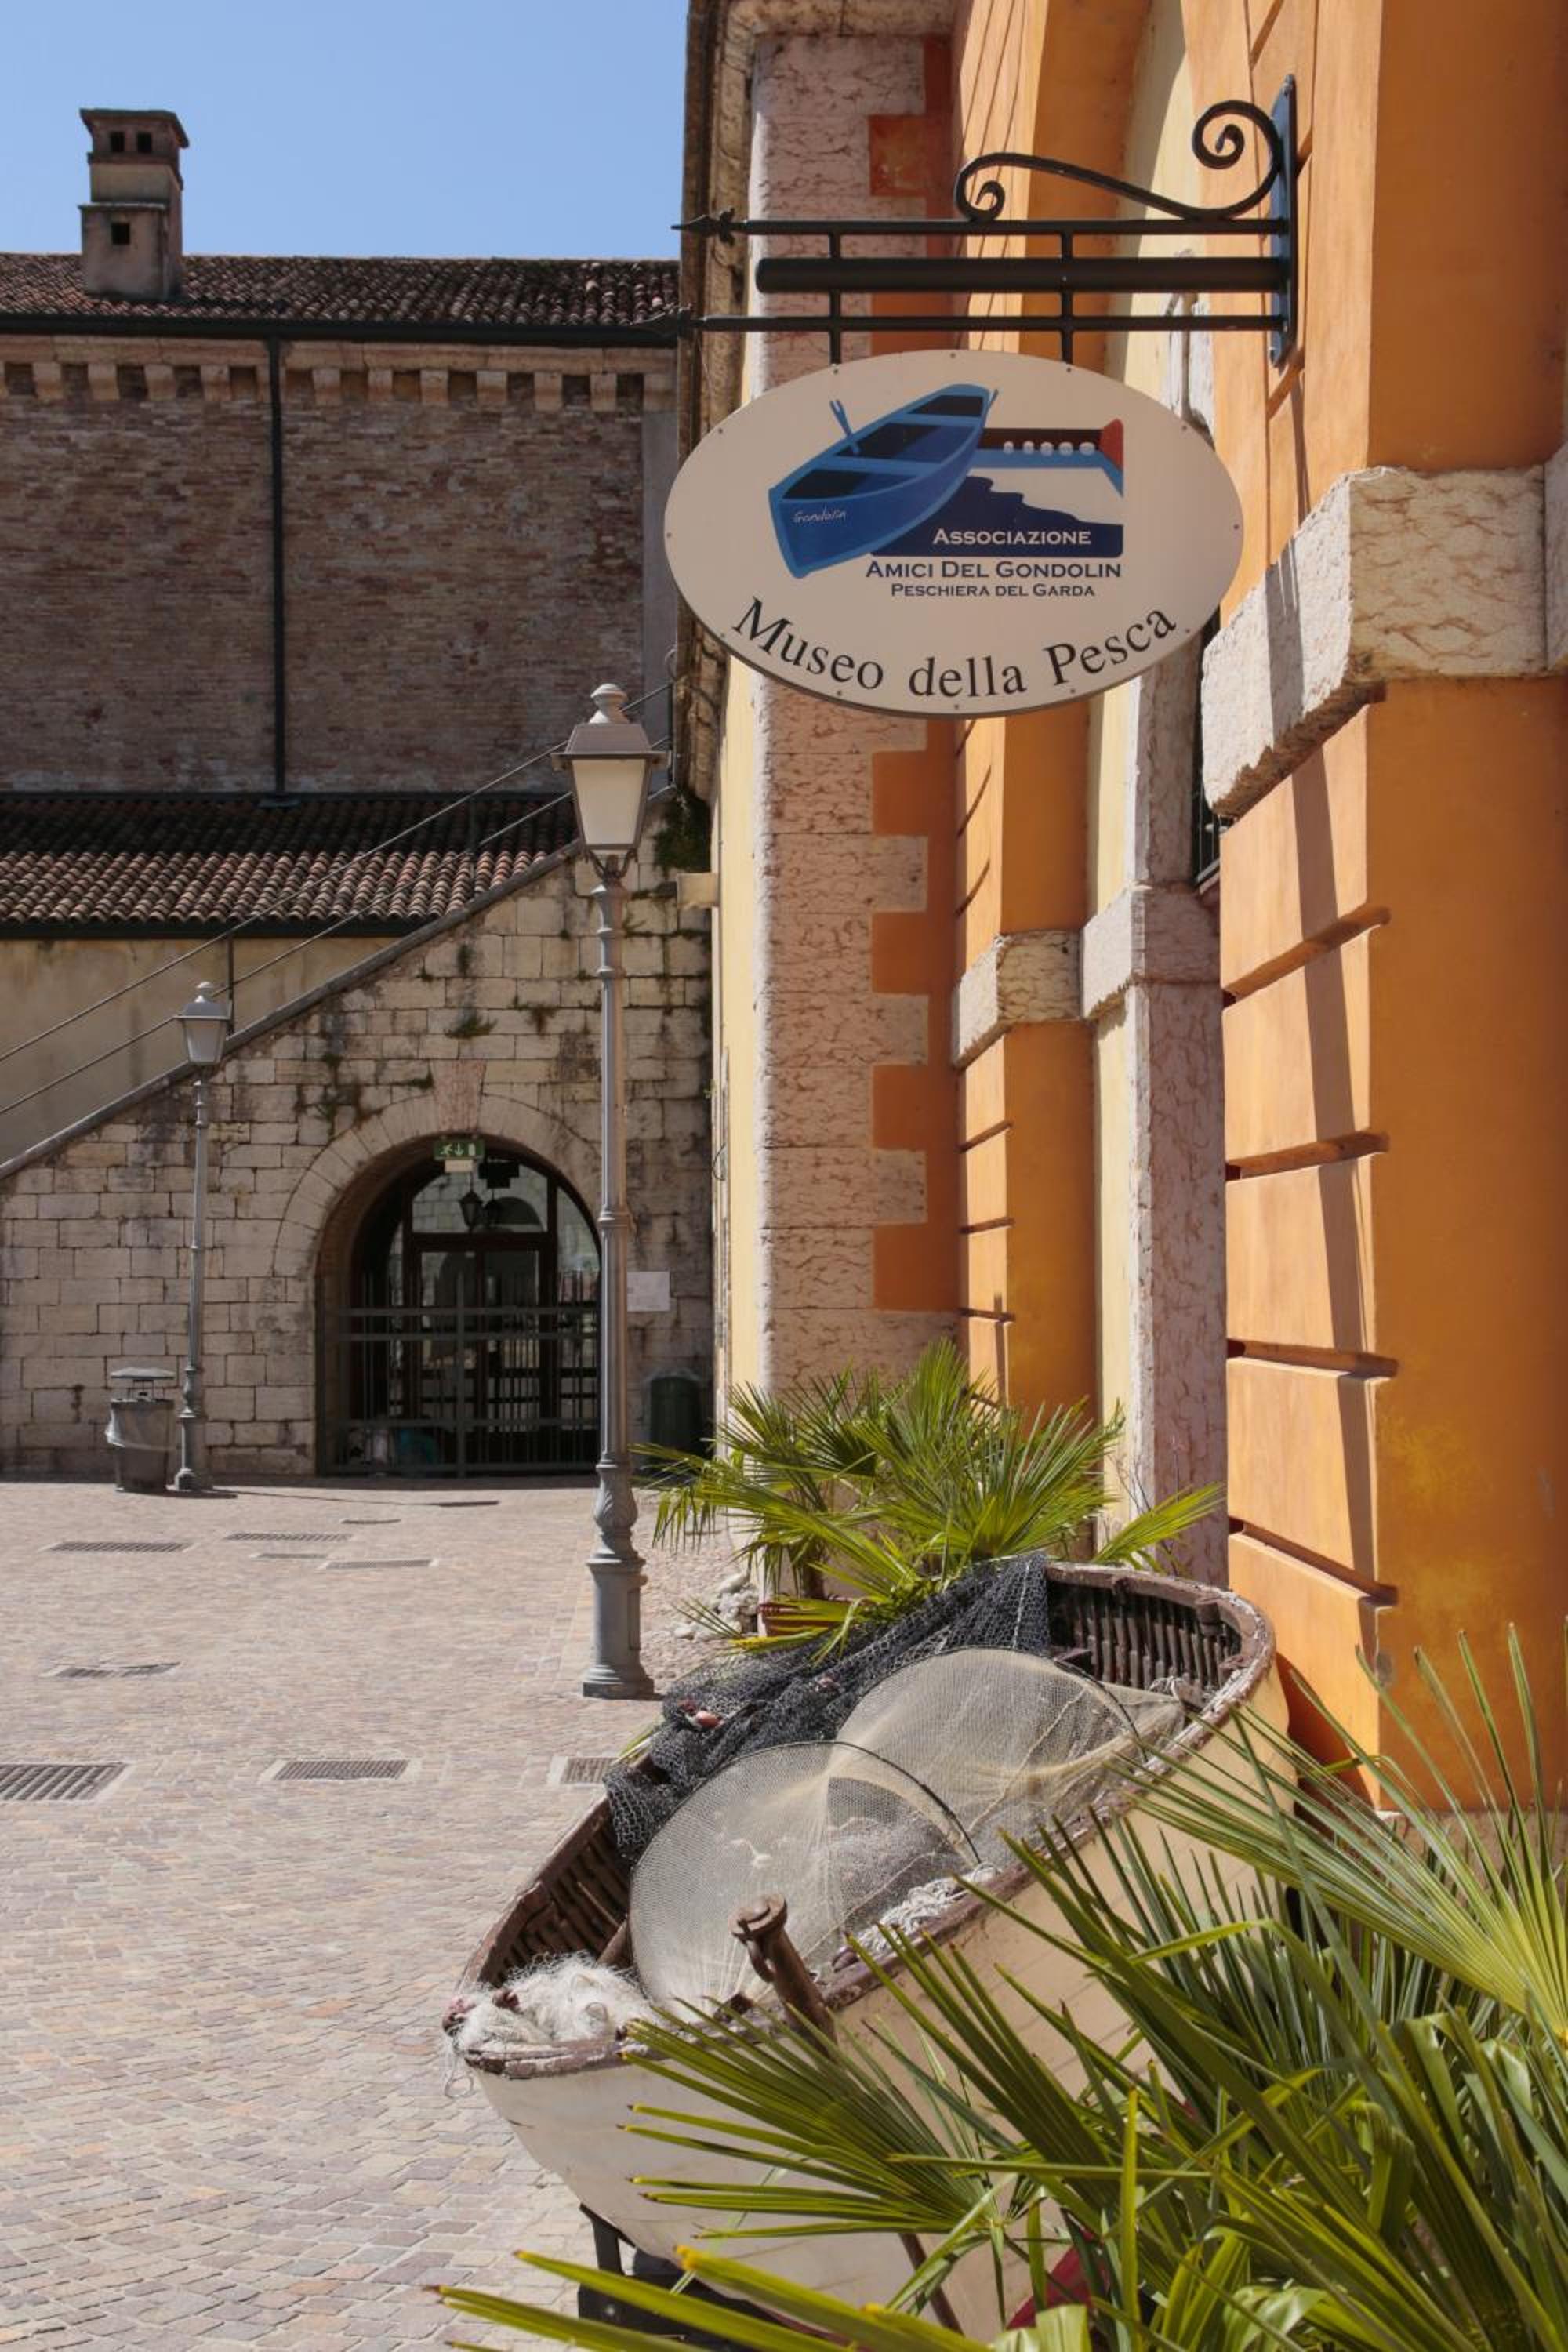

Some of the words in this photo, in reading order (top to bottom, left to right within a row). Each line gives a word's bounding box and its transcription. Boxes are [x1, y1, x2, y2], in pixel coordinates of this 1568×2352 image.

[932, 528, 1092, 546] ASSOCIAZIONE
[866, 561, 934, 579] AMICI
[996, 561, 1122, 579] GONDOLIN
[891, 583, 990, 597] PESCHIERA
[1032, 583, 1096, 597] GARDA
[731, 595, 884, 690] Museo
[908, 655, 1028, 698] della
[1042, 608, 1177, 686] Pesca
